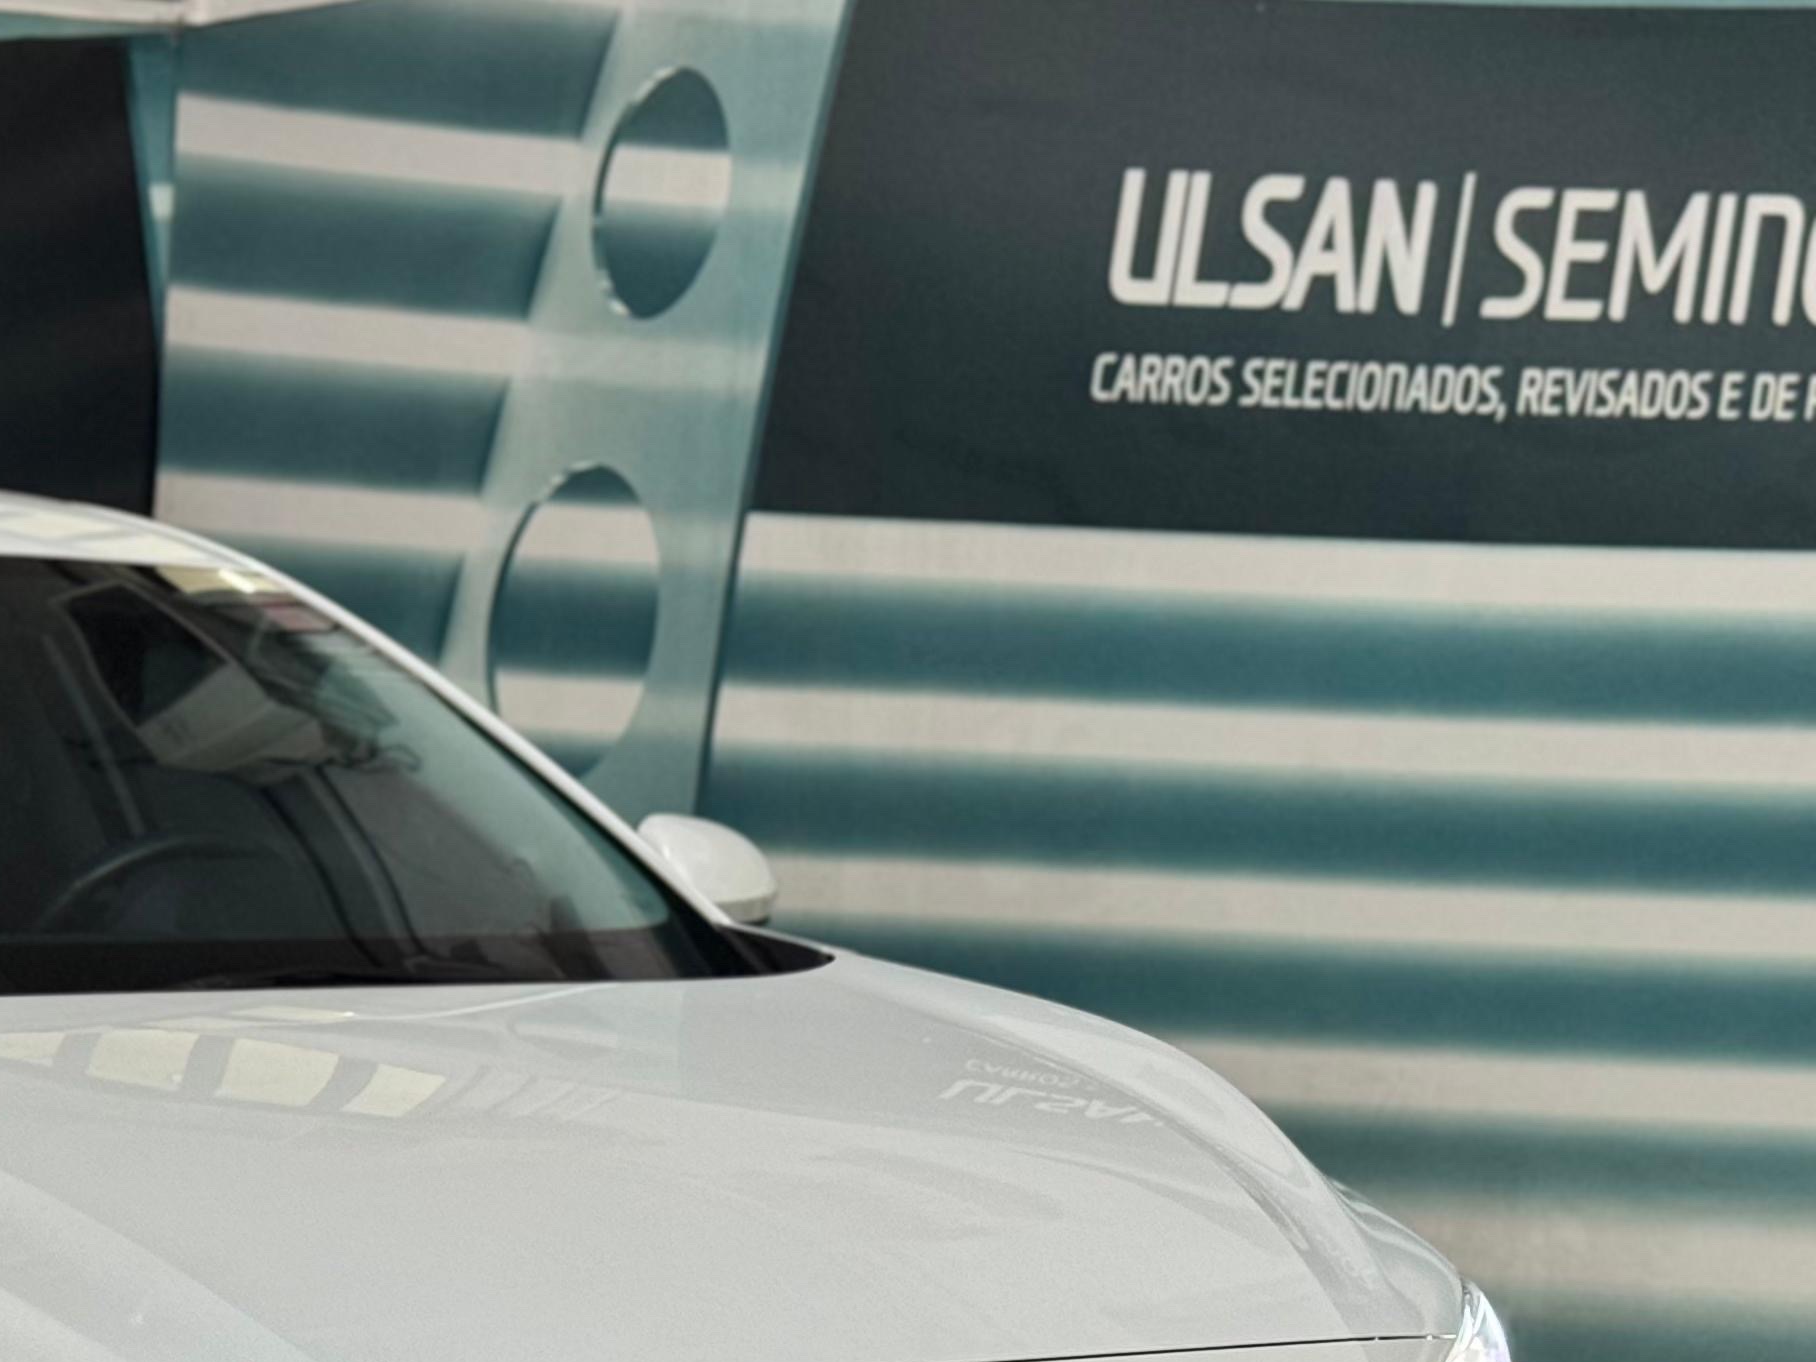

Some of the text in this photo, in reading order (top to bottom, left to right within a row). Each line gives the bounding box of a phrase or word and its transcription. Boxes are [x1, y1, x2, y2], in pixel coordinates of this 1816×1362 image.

[1108, 167, 1816, 326] ULSAN SEMIN
[1090, 351, 1235, 406] CARROS
[1239, 355, 1507, 423] SELECIONADOS,
[1515, 367, 1714, 422] REVISADOS
[1716, 370, 1747, 421] E
[1748, 371, 1802, 422] DE
